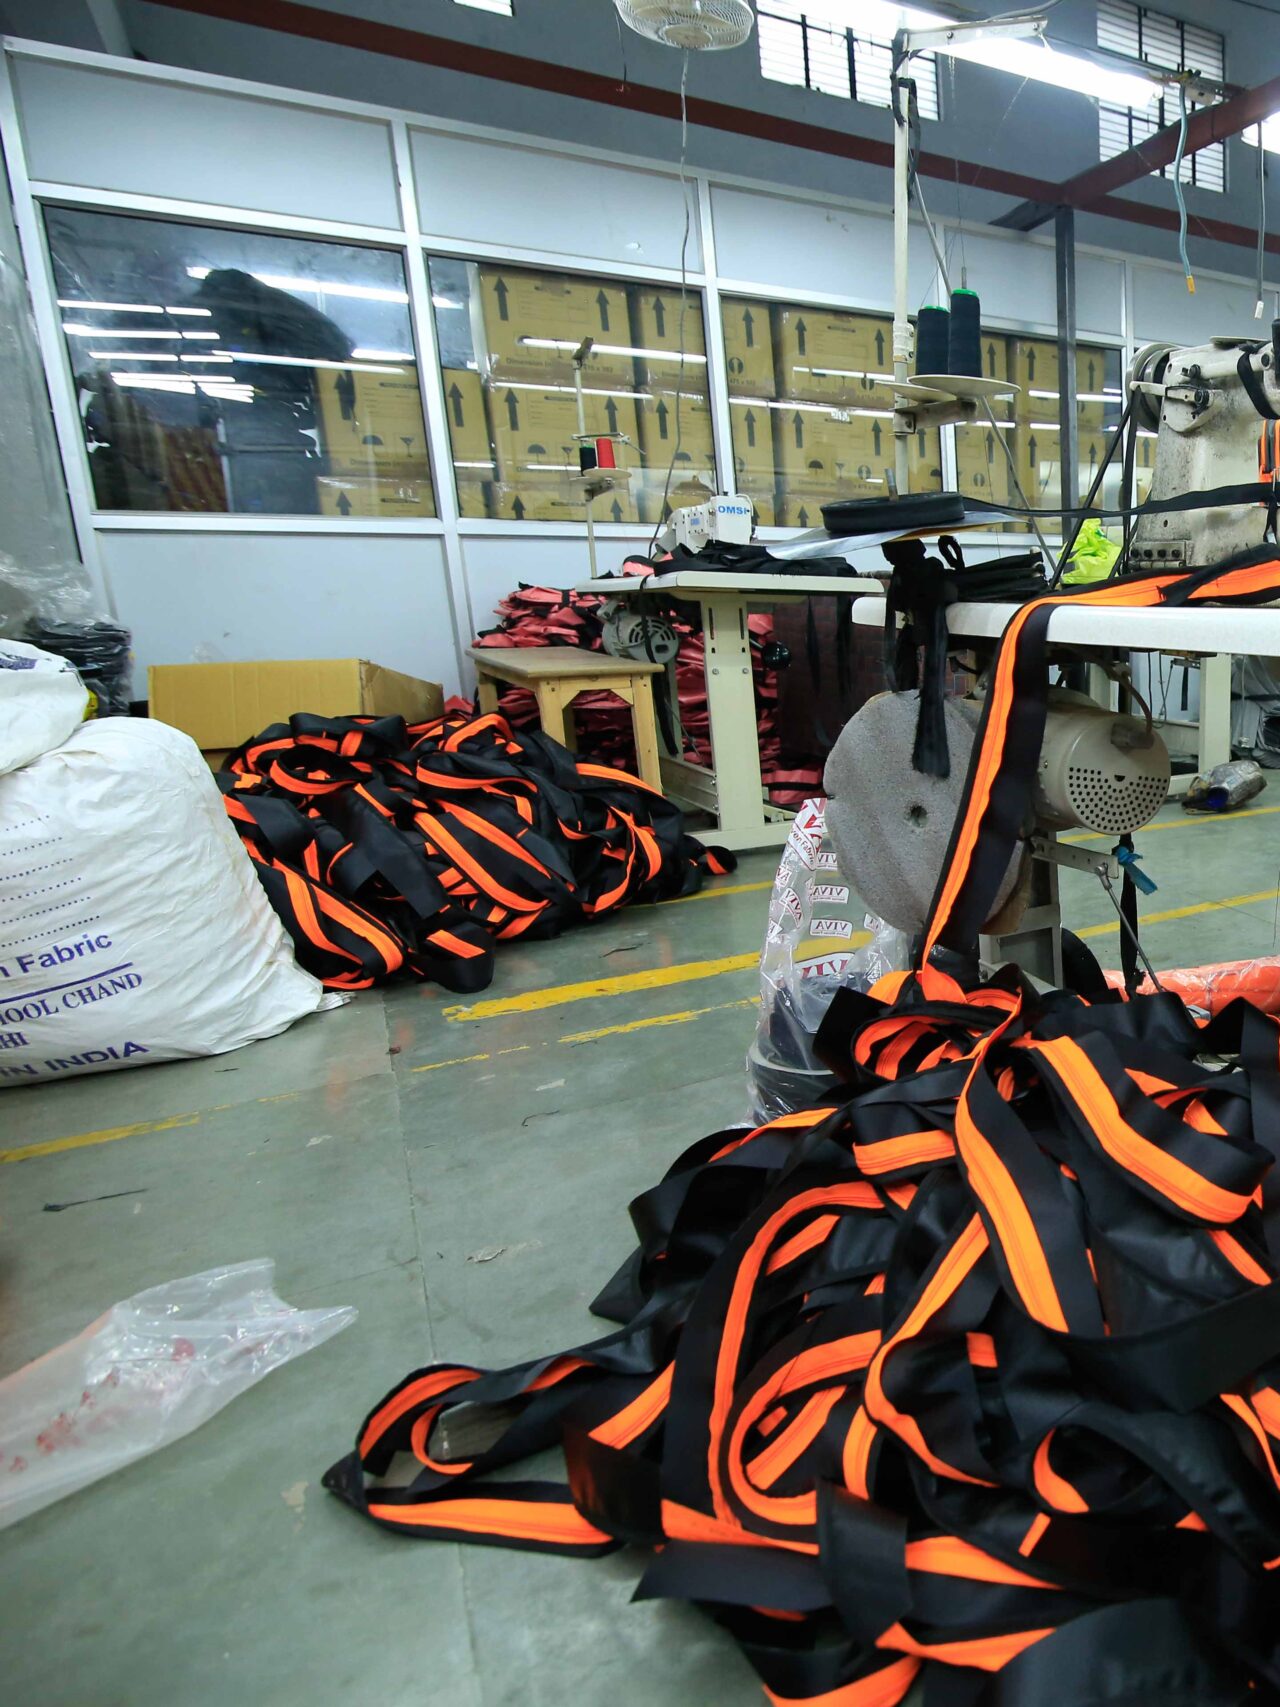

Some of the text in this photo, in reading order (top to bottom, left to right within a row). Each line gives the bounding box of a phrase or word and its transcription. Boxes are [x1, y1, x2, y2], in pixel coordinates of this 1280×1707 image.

[16, 933, 113, 974] Fabric
[62, 972, 143, 1009] CHAND
[0, 1031, 30, 1049] HI
[45, 1040, 150, 1072] INDIA
